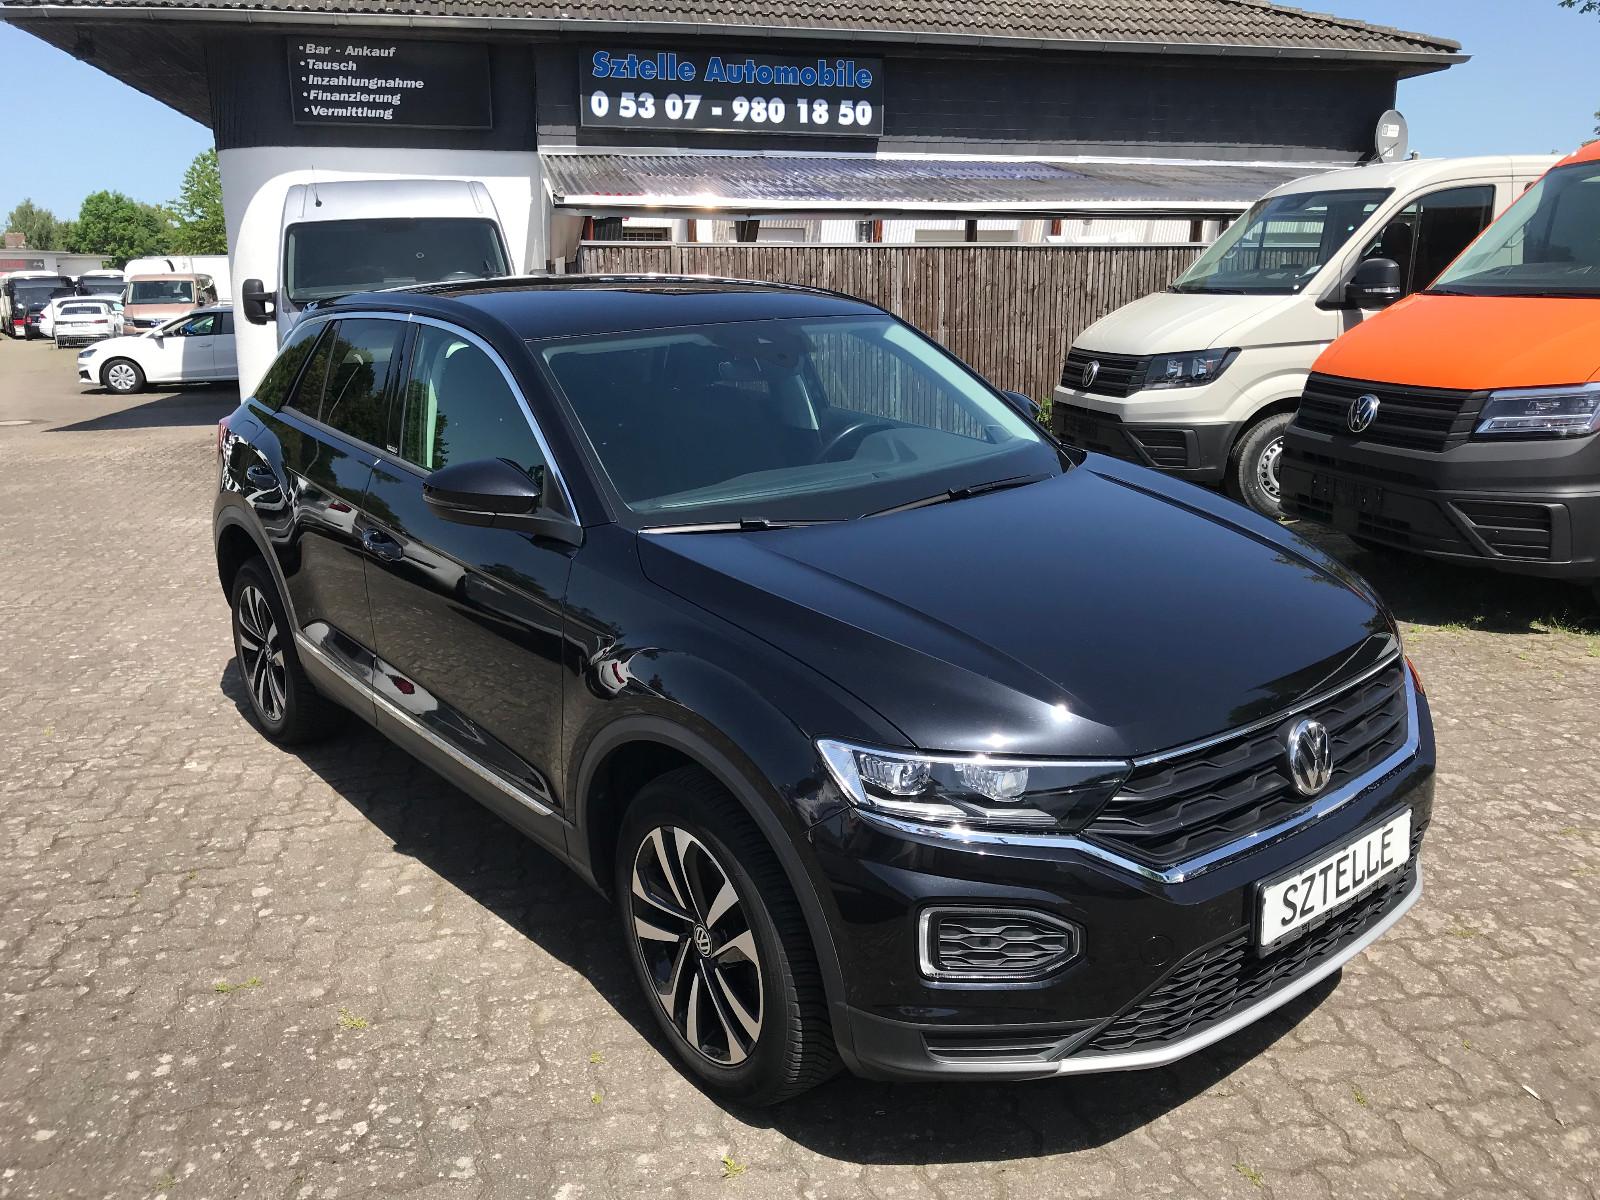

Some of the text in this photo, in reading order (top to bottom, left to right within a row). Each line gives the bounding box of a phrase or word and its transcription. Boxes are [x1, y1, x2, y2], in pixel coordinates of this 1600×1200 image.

[305, 43, 332, 55] Bar
[344, 45, 397, 58] Ankauf
[307, 58, 357, 71] Tausch
[591, 50, 873, 89] Sztelle Automobile
[308, 74, 425, 90] Inzahlungnahme
[309, 89, 402, 106] Finanzierung
[310, 105, 394, 120] Vermittlung
[590, 90, 610, 118] 0
[618, 91, 656, 119] 53
[664, 93, 703, 120] 07
[732, 96, 786, 124] 980
[796, 98, 829, 125] 18
[837, 99, 873, 126] 50
[1280, 827, 1394, 927] SZTELLE
